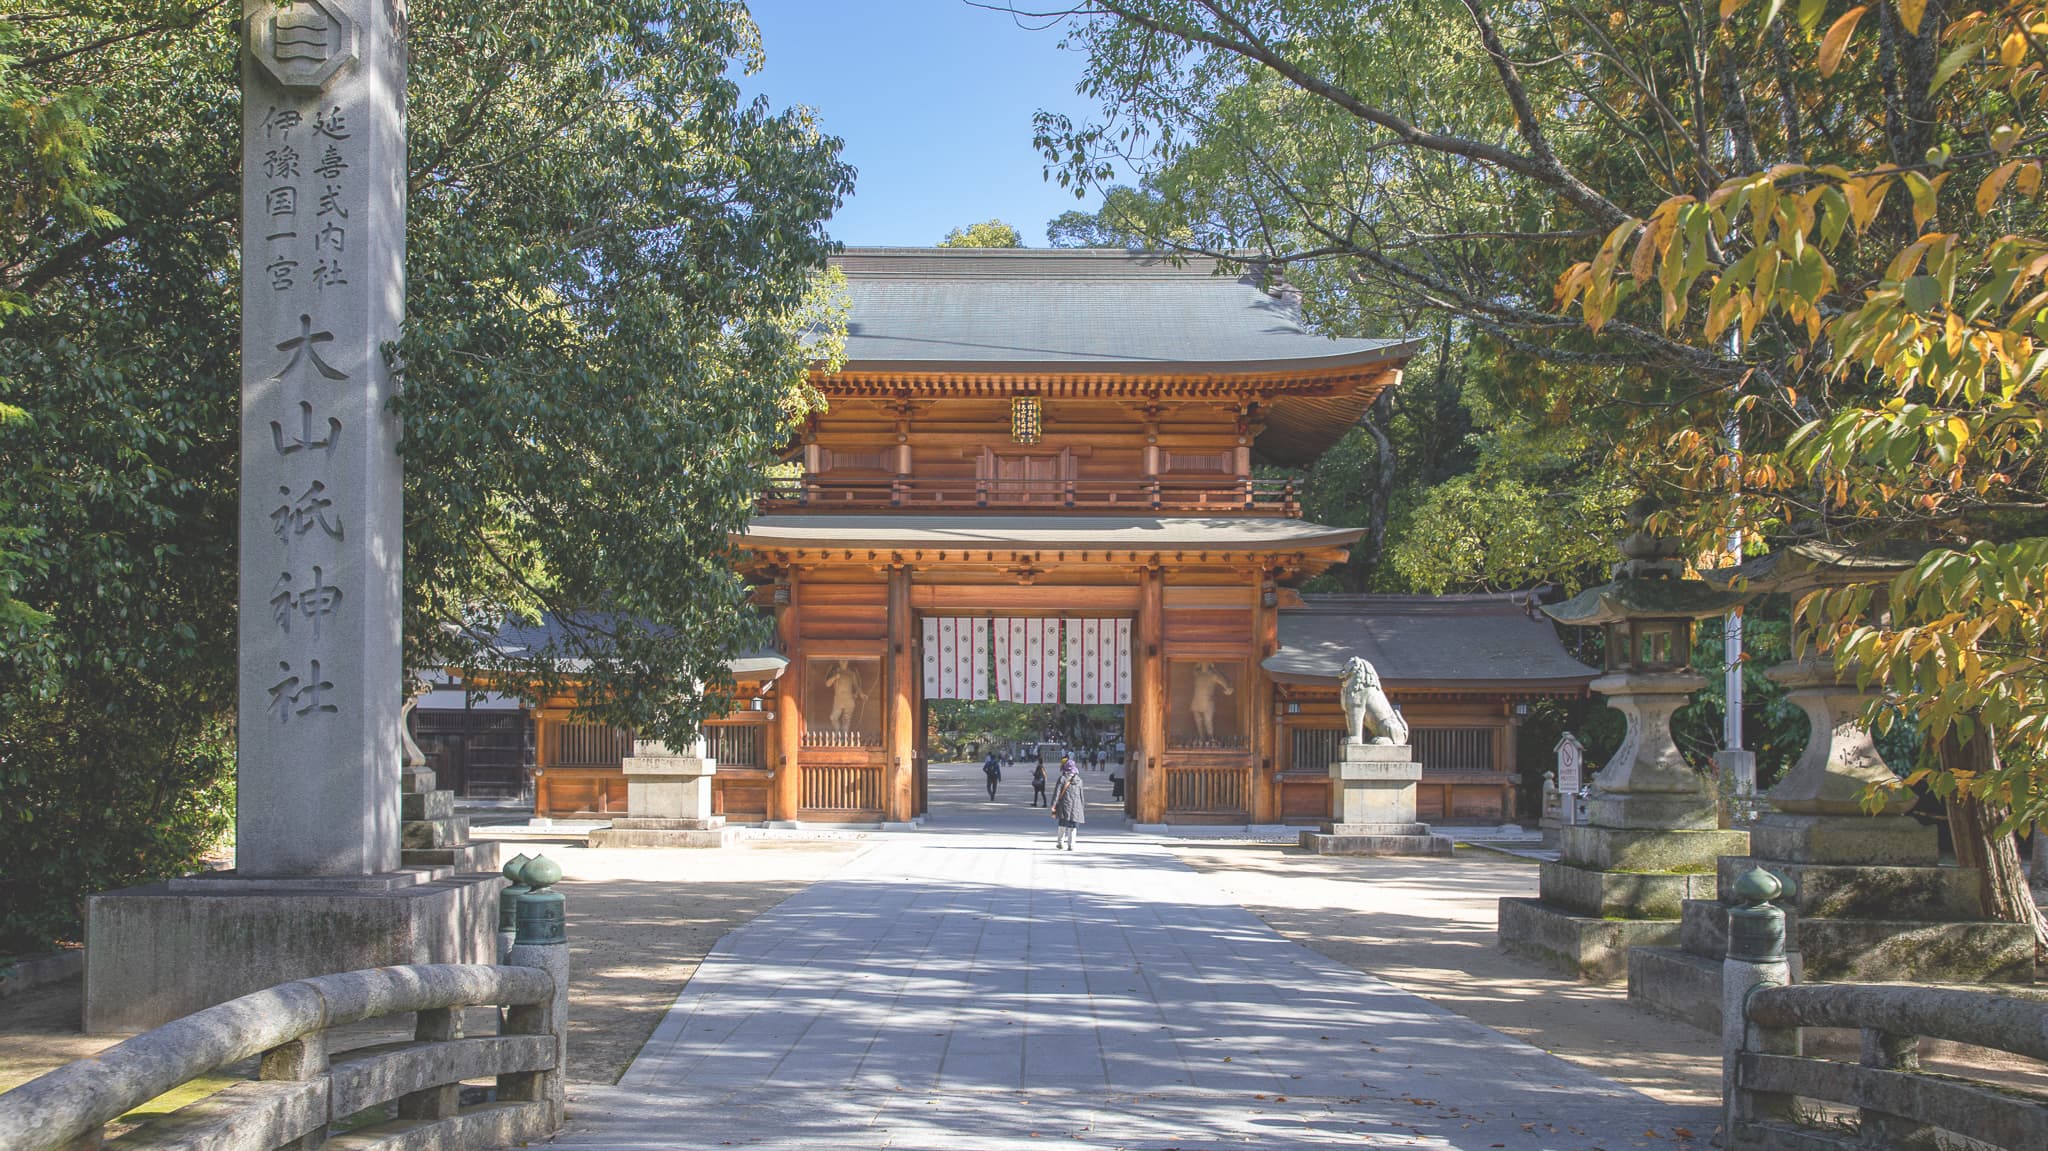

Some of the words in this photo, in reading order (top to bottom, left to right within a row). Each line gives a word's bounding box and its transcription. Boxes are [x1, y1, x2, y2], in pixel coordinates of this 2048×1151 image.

[312, 105, 351, 290] 延喜式内社
[267, 313, 349, 723] 大山祇神社
